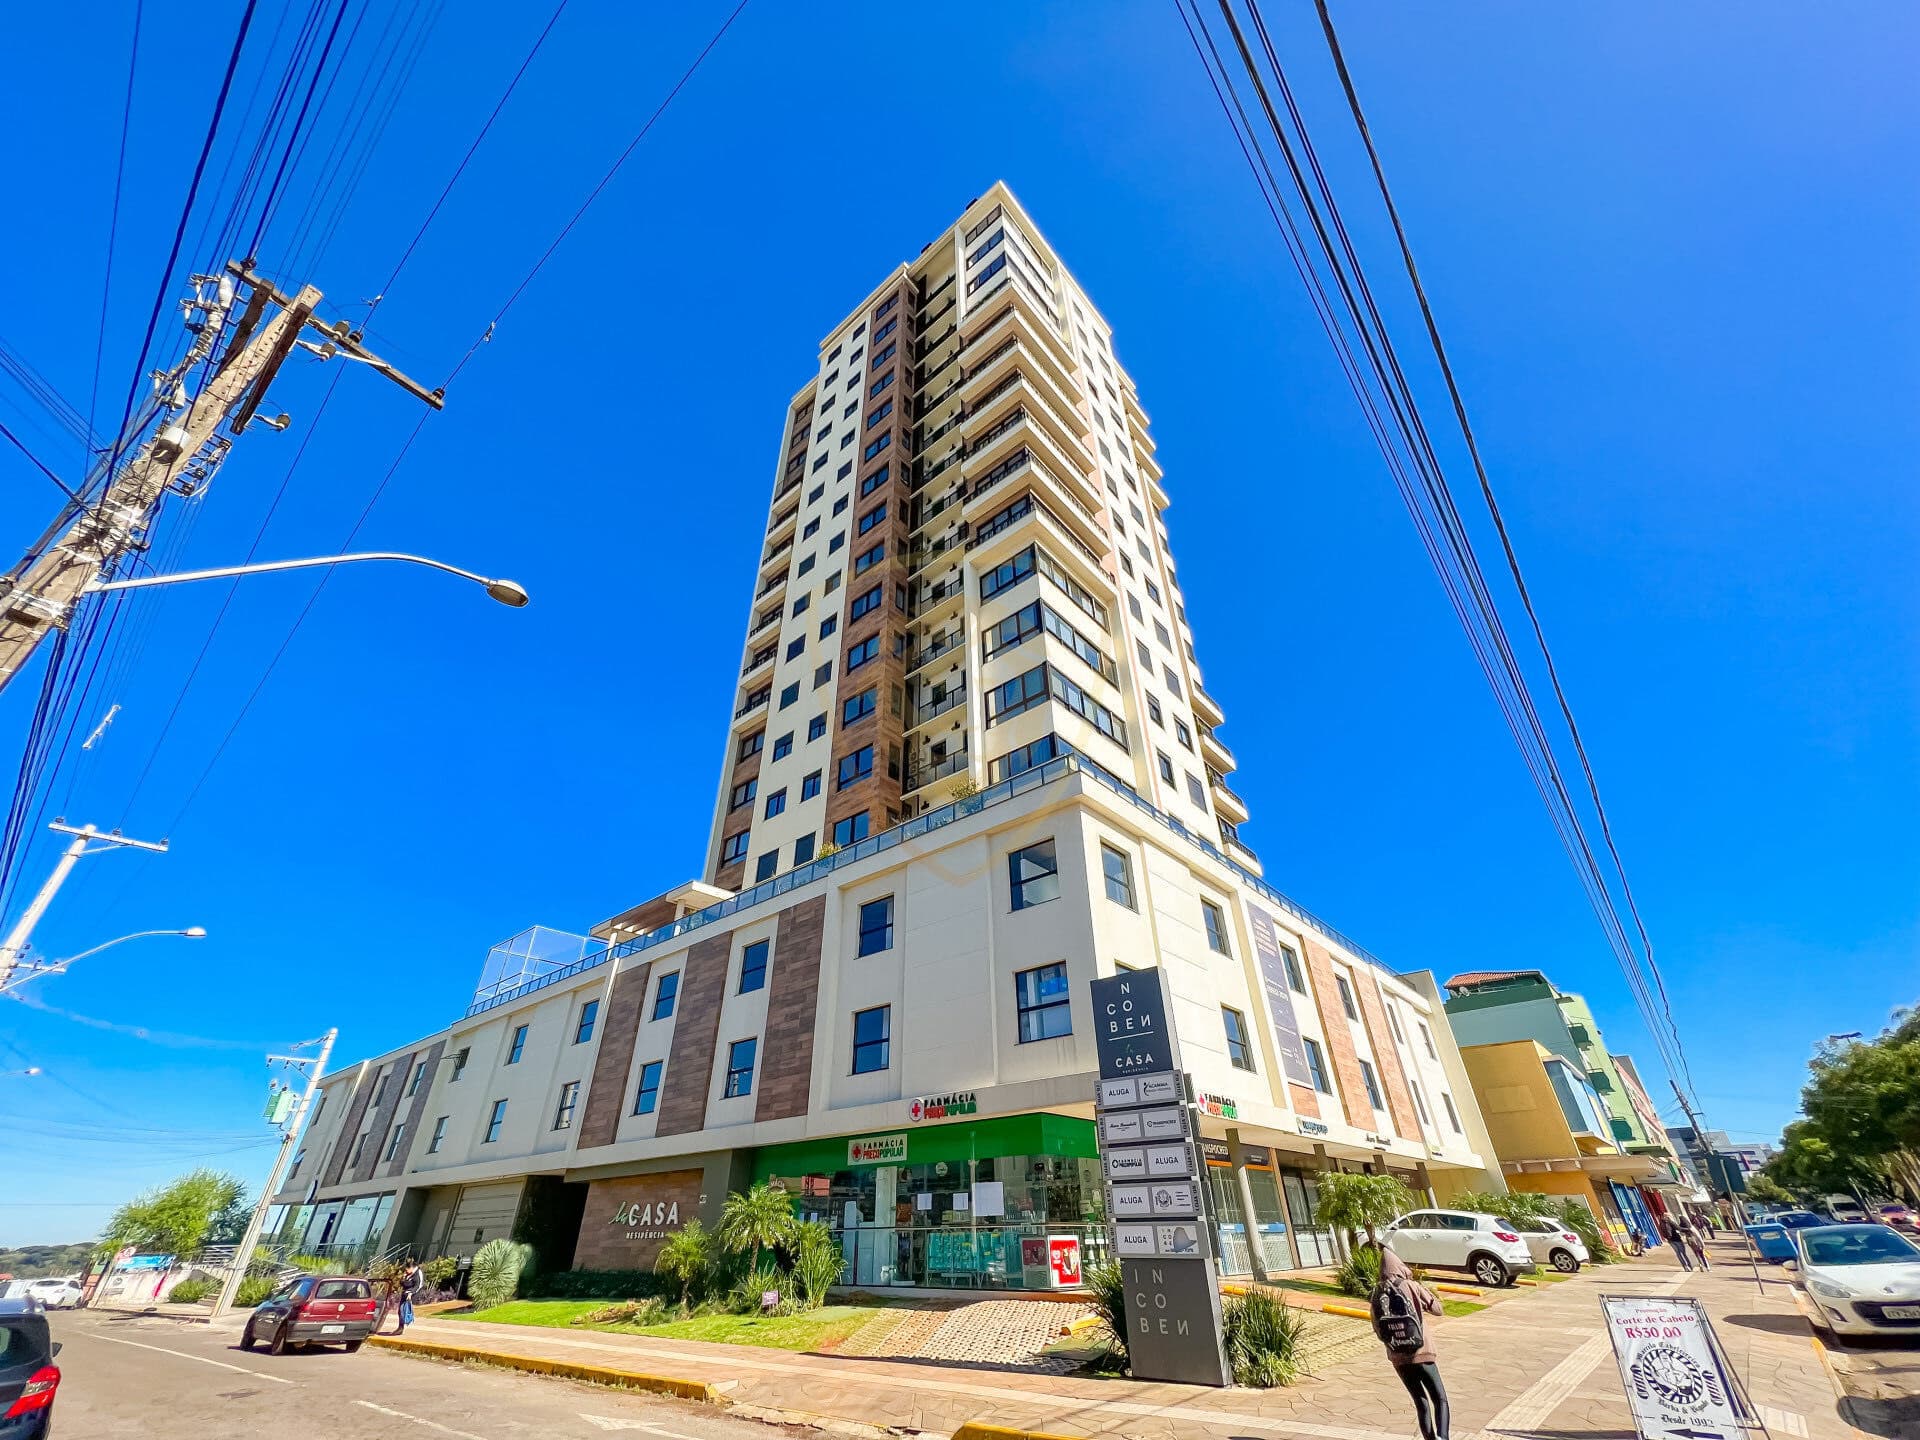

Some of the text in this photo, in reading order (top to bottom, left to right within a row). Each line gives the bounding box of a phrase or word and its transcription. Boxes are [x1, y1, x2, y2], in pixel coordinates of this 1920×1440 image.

[1115, 1053, 1154, 1068] CASA
[1108, 1087, 1130, 1097] ALUGA
[924, 1092, 977, 1108] FARMÁCIA
[863, 1138, 904, 1150] FARMÁCIA
[1155, 1156, 1179, 1165] ALUGA
[1120, 1196, 1143, 1204] ALUGA
[628, 1201, 679, 1227] CASA
[1123, 1236, 1148, 1244] ALUGA
[1134, 1268, 1164, 1285] IN
[1616, 1314, 1695, 1325] Corte de Cabelo
[1660, 1413, 1687, 1425] Desde
